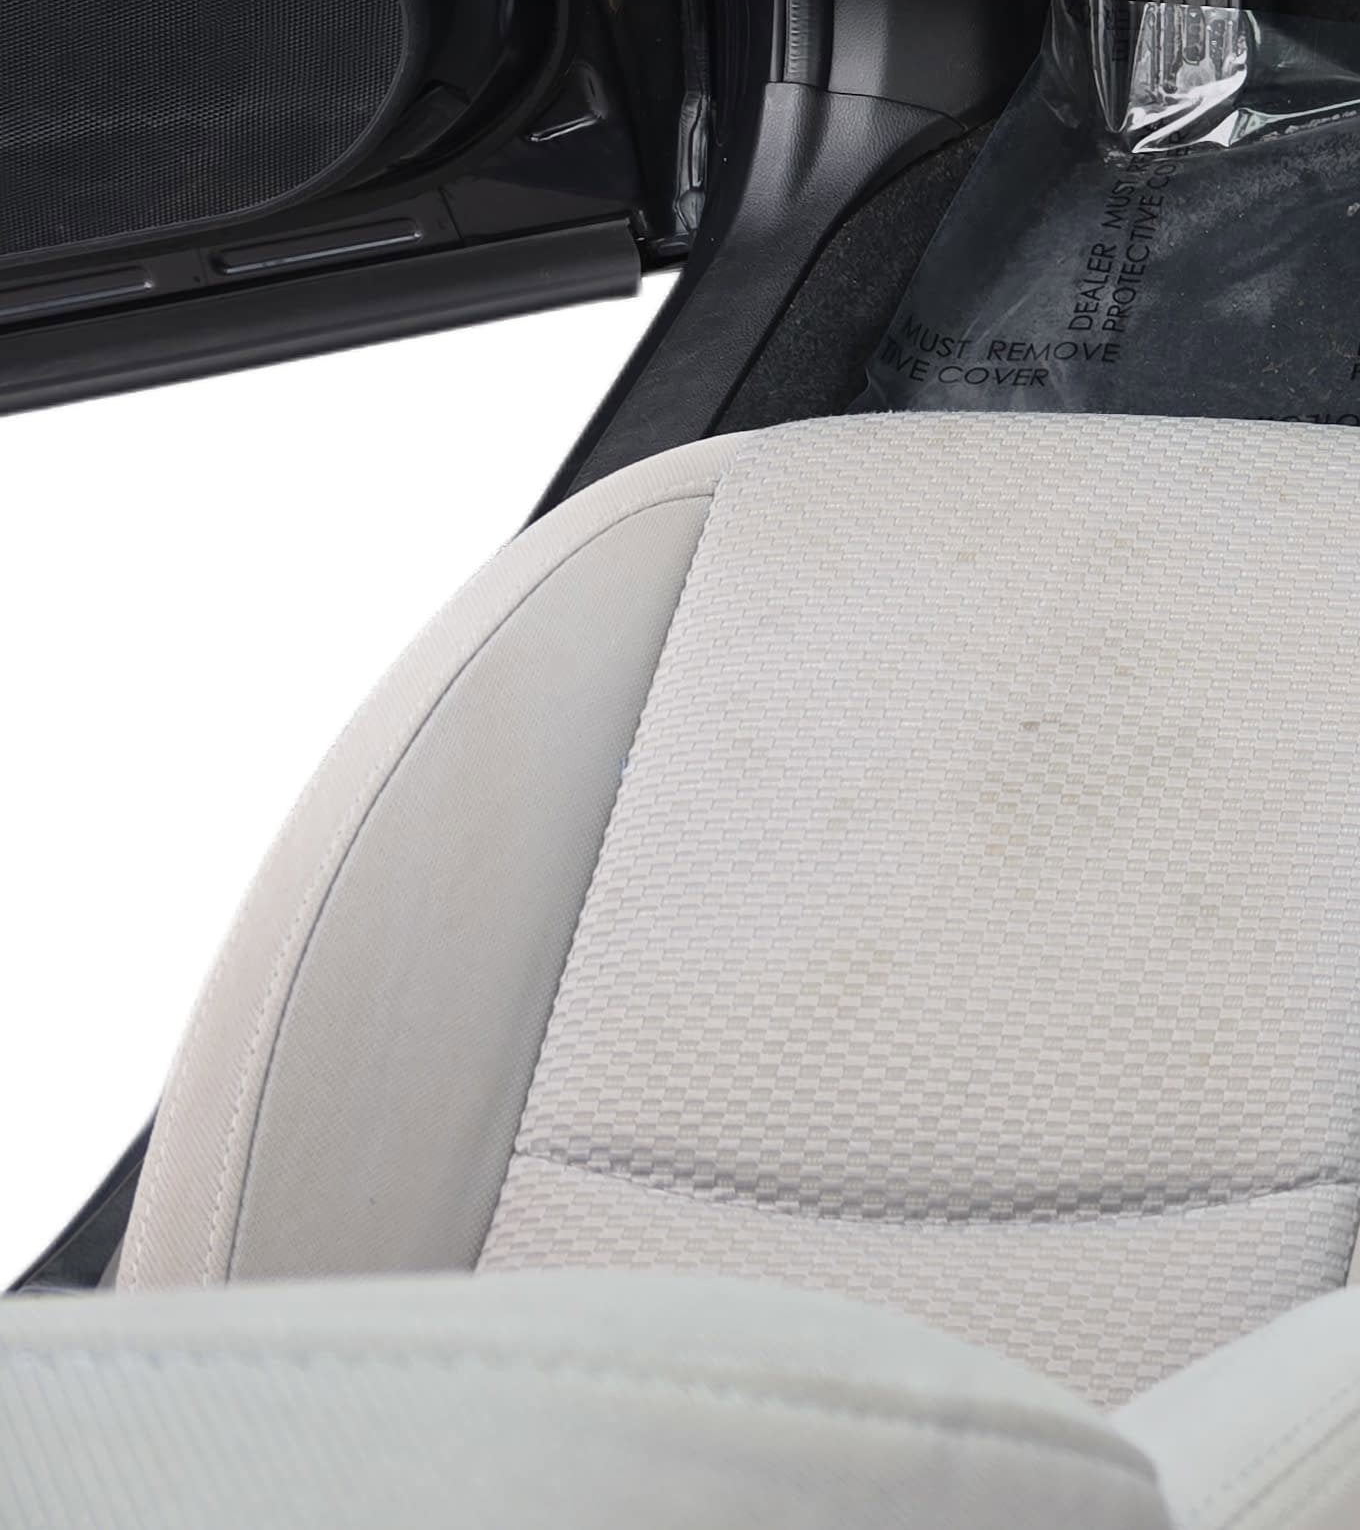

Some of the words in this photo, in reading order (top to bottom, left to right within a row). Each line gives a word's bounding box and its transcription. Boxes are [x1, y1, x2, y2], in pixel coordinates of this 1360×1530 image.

[1068, 241, 1119, 331] DEALER
[1101, 178, 1138, 230] MUST
[1101, 195, 1162, 332] PROTECTIVE
[900, 315, 973, 358] MUST
[987, 340, 1121, 363] REMOVE
[937, 365, 1050, 387] COVER
